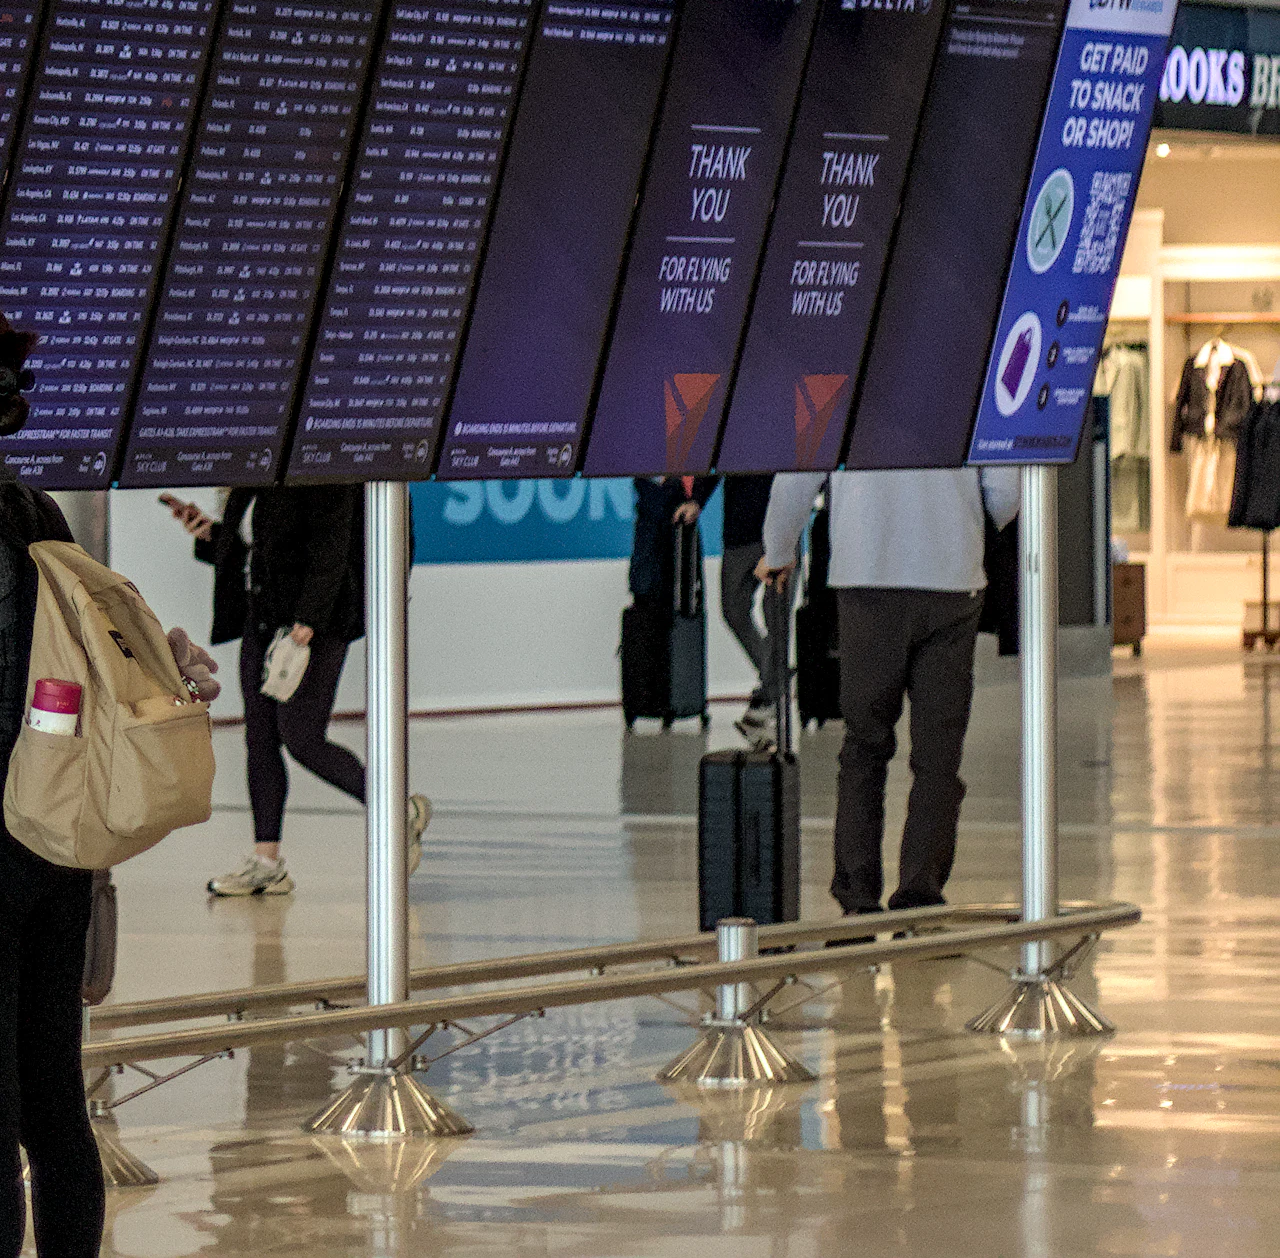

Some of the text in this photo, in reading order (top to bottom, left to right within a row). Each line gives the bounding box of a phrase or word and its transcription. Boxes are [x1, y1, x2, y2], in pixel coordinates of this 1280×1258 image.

[1081, 42, 1148, 76] GET PAID
[1159, 45, 1245, 108] OOKS
[1070, 80, 1143, 113] TO SNACK
[1063, 116, 1133, 149] OR SHOP!
[690, 144, 751, 180] THANK
[821, 152, 879, 186] THANK
[691, 188, 730, 222] YOU
[822, 194, 859, 227] YOU
[659, 256, 731, 283] FOR FLYING
[791, 260, 859, 286] FOR FLYING
[661, 288, 715, 313] WITH US
[792, 291, 843, 316] WITH US
